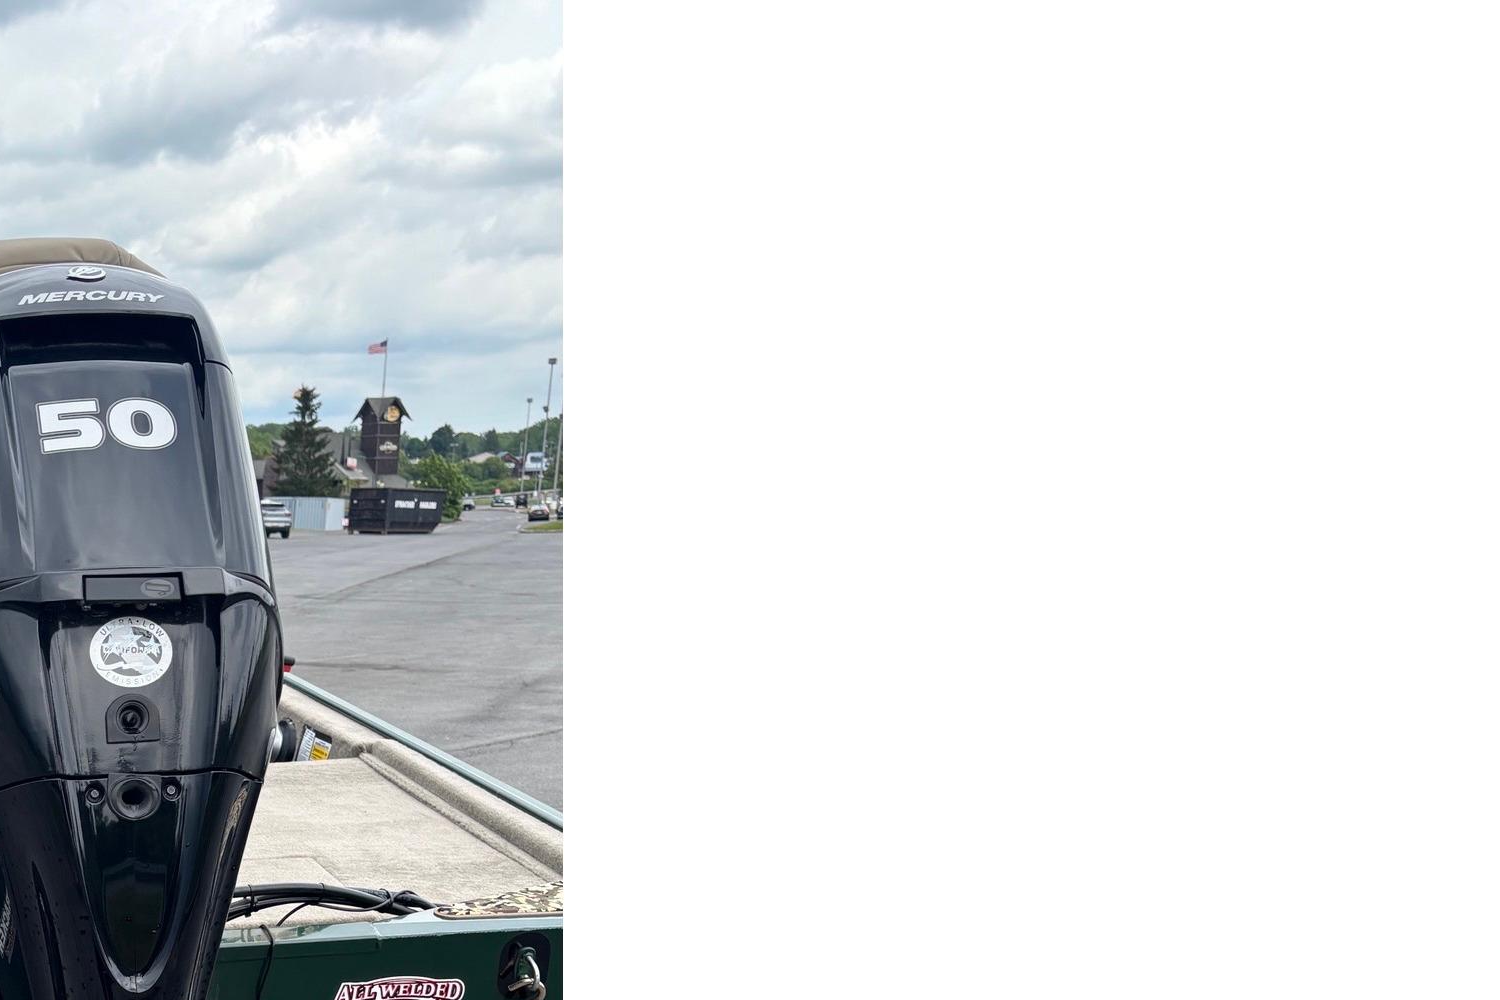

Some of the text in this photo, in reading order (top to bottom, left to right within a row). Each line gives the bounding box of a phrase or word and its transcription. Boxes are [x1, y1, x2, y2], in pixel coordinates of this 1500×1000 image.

[18, 290, 164, 306] MERCURY
[36, 398, 177, 454] 50
[100, 617, 165, 638] ULRA LOW
[380, 981, 461, 1000] WELDED
